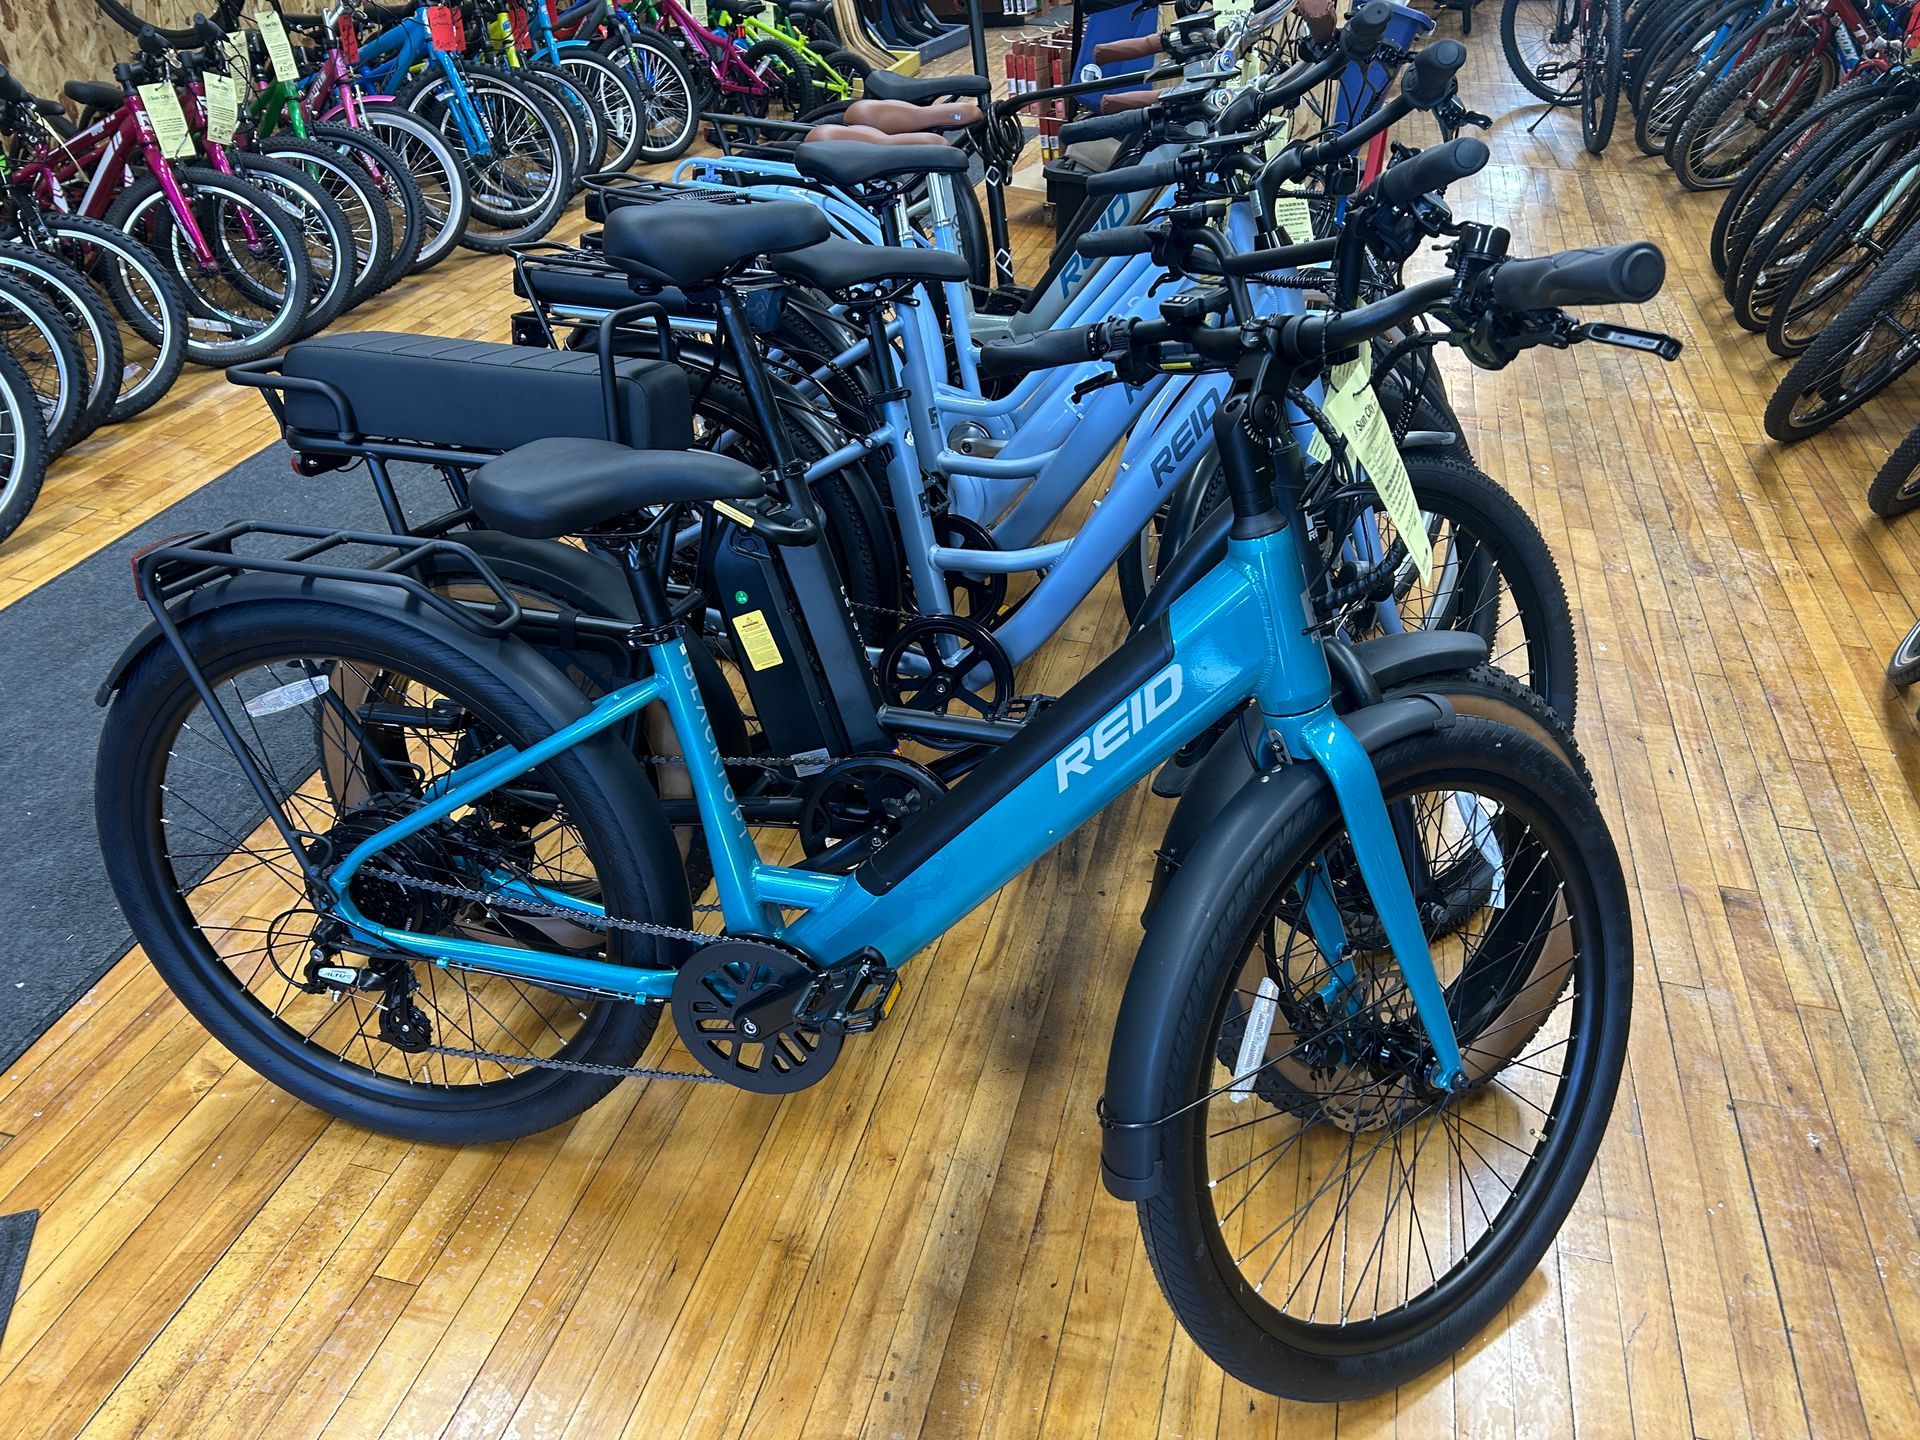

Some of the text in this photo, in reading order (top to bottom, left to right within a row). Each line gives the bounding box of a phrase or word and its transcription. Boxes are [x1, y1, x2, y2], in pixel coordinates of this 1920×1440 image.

[1150, 387, 1221, 489] REID
[1355, 404, 1376, 432] Sun City
[1055, 663, 1183, 794] REID
